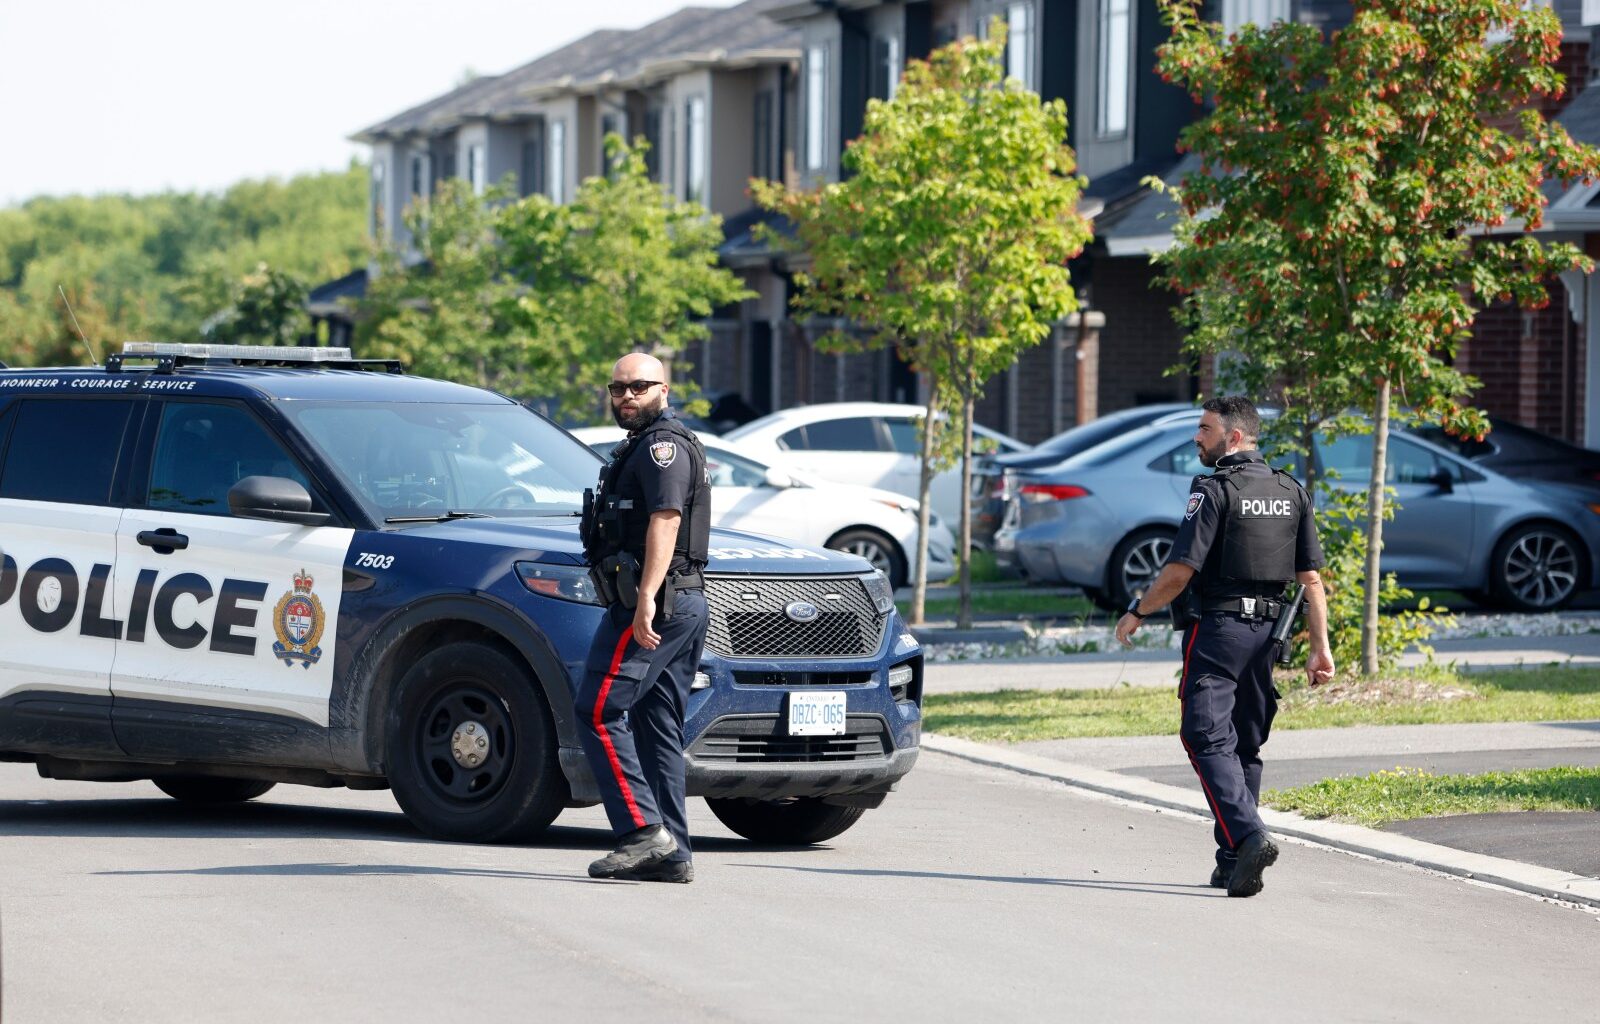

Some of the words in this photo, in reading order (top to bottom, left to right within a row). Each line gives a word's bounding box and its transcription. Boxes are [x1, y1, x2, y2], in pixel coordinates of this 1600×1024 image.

[0, 378, 59, 388] HONNEUR
[71, 379, 131, 389] COURAGE
[141, 380, 197, 390] SERVICE
[1241, 499, 1291, 516] POLICE
[355, 552, 395, 569] 7503
